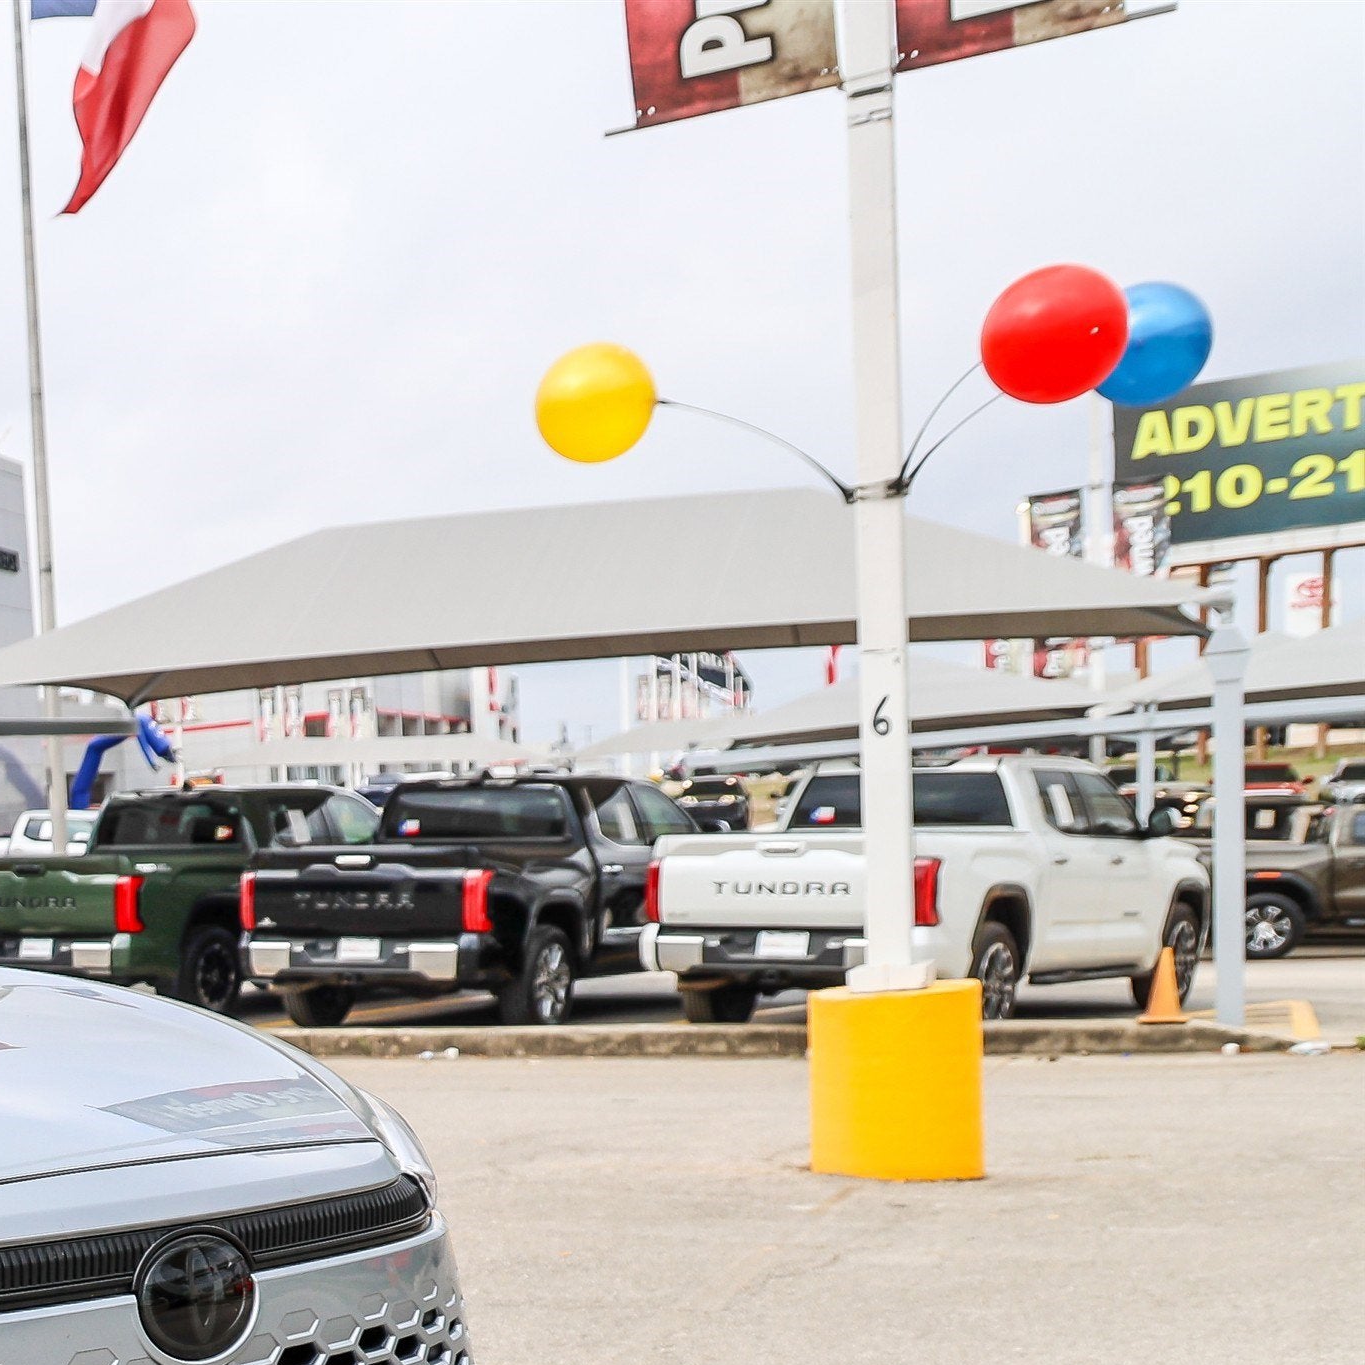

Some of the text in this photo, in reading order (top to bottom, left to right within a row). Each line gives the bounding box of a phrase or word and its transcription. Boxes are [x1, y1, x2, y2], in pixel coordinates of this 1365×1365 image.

[1131, 382, 1365, 460] ADVERT
[872, 695, 889, 735] 6
[293, 891, 415, 910] TUNDRA
[712, 881, 852, 896] TUNDRA
